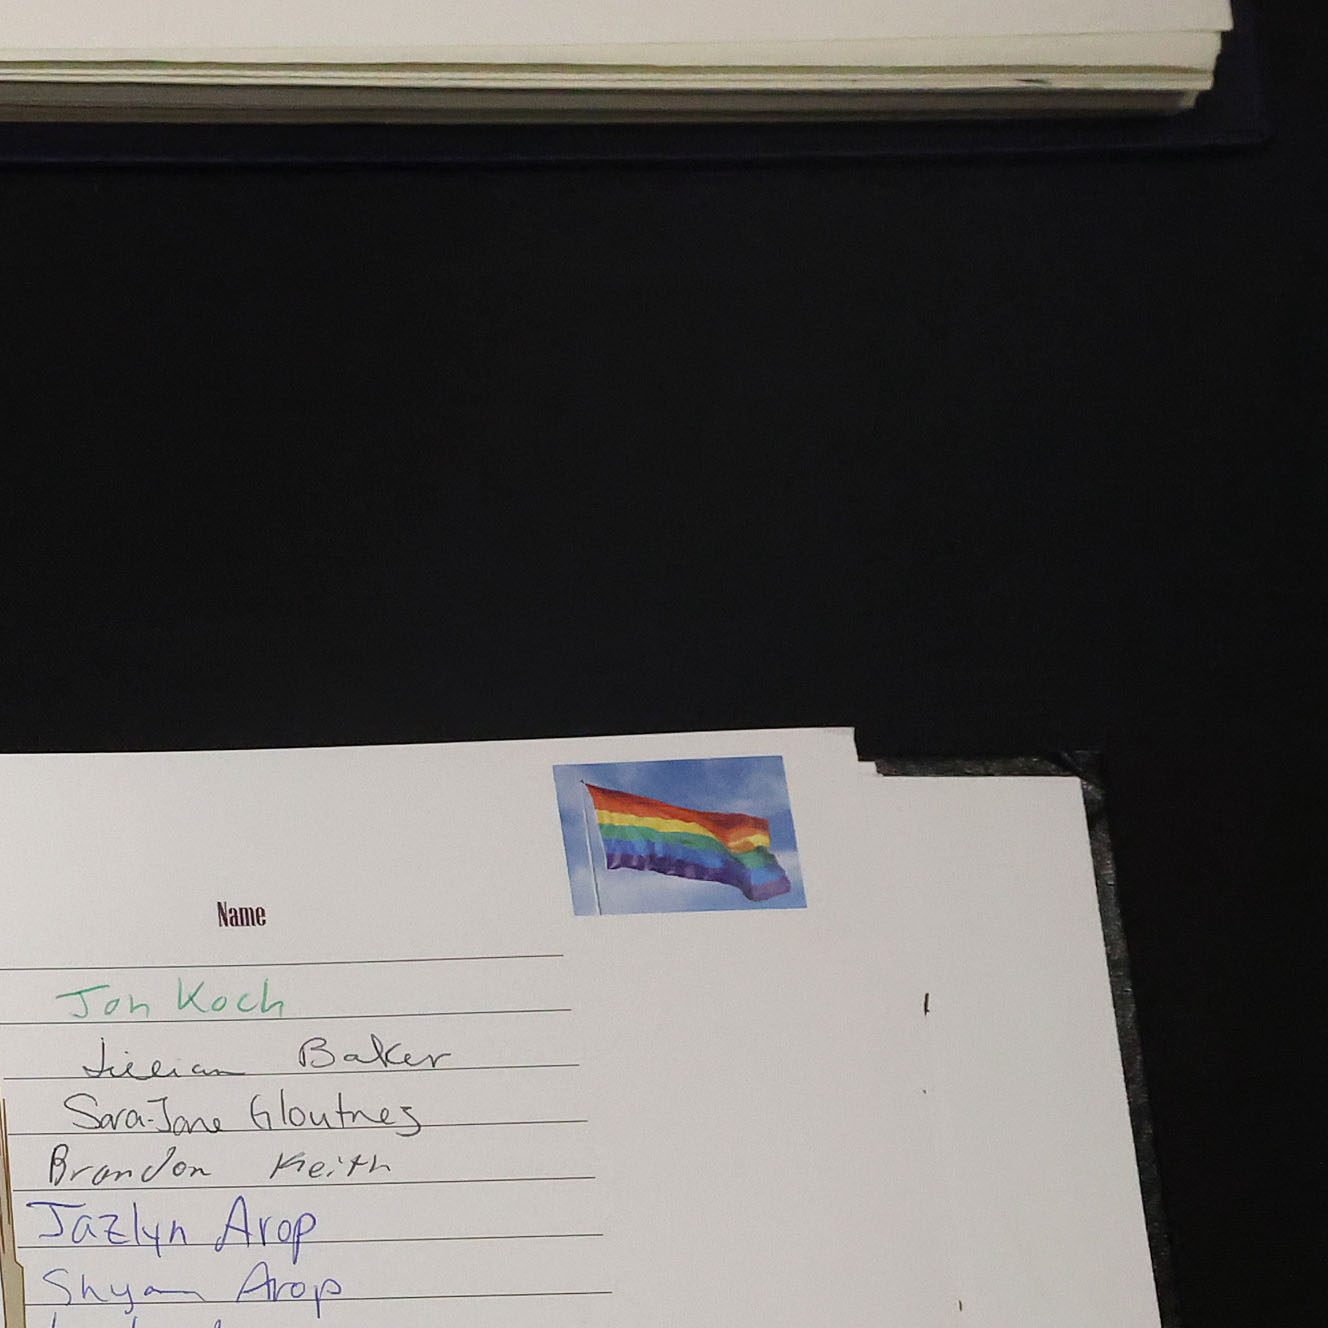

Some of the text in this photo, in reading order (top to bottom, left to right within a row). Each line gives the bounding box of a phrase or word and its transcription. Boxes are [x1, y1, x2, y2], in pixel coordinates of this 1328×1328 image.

[216, 901, 267, 928] Name
[55, 976, 284, 1019] Jon Koch
[297, 1033, 452, 1070] Baker
[47, 1143, 213, 1187] Brandon
[26, 1194, 318, 1265] Jazlyn Arop
